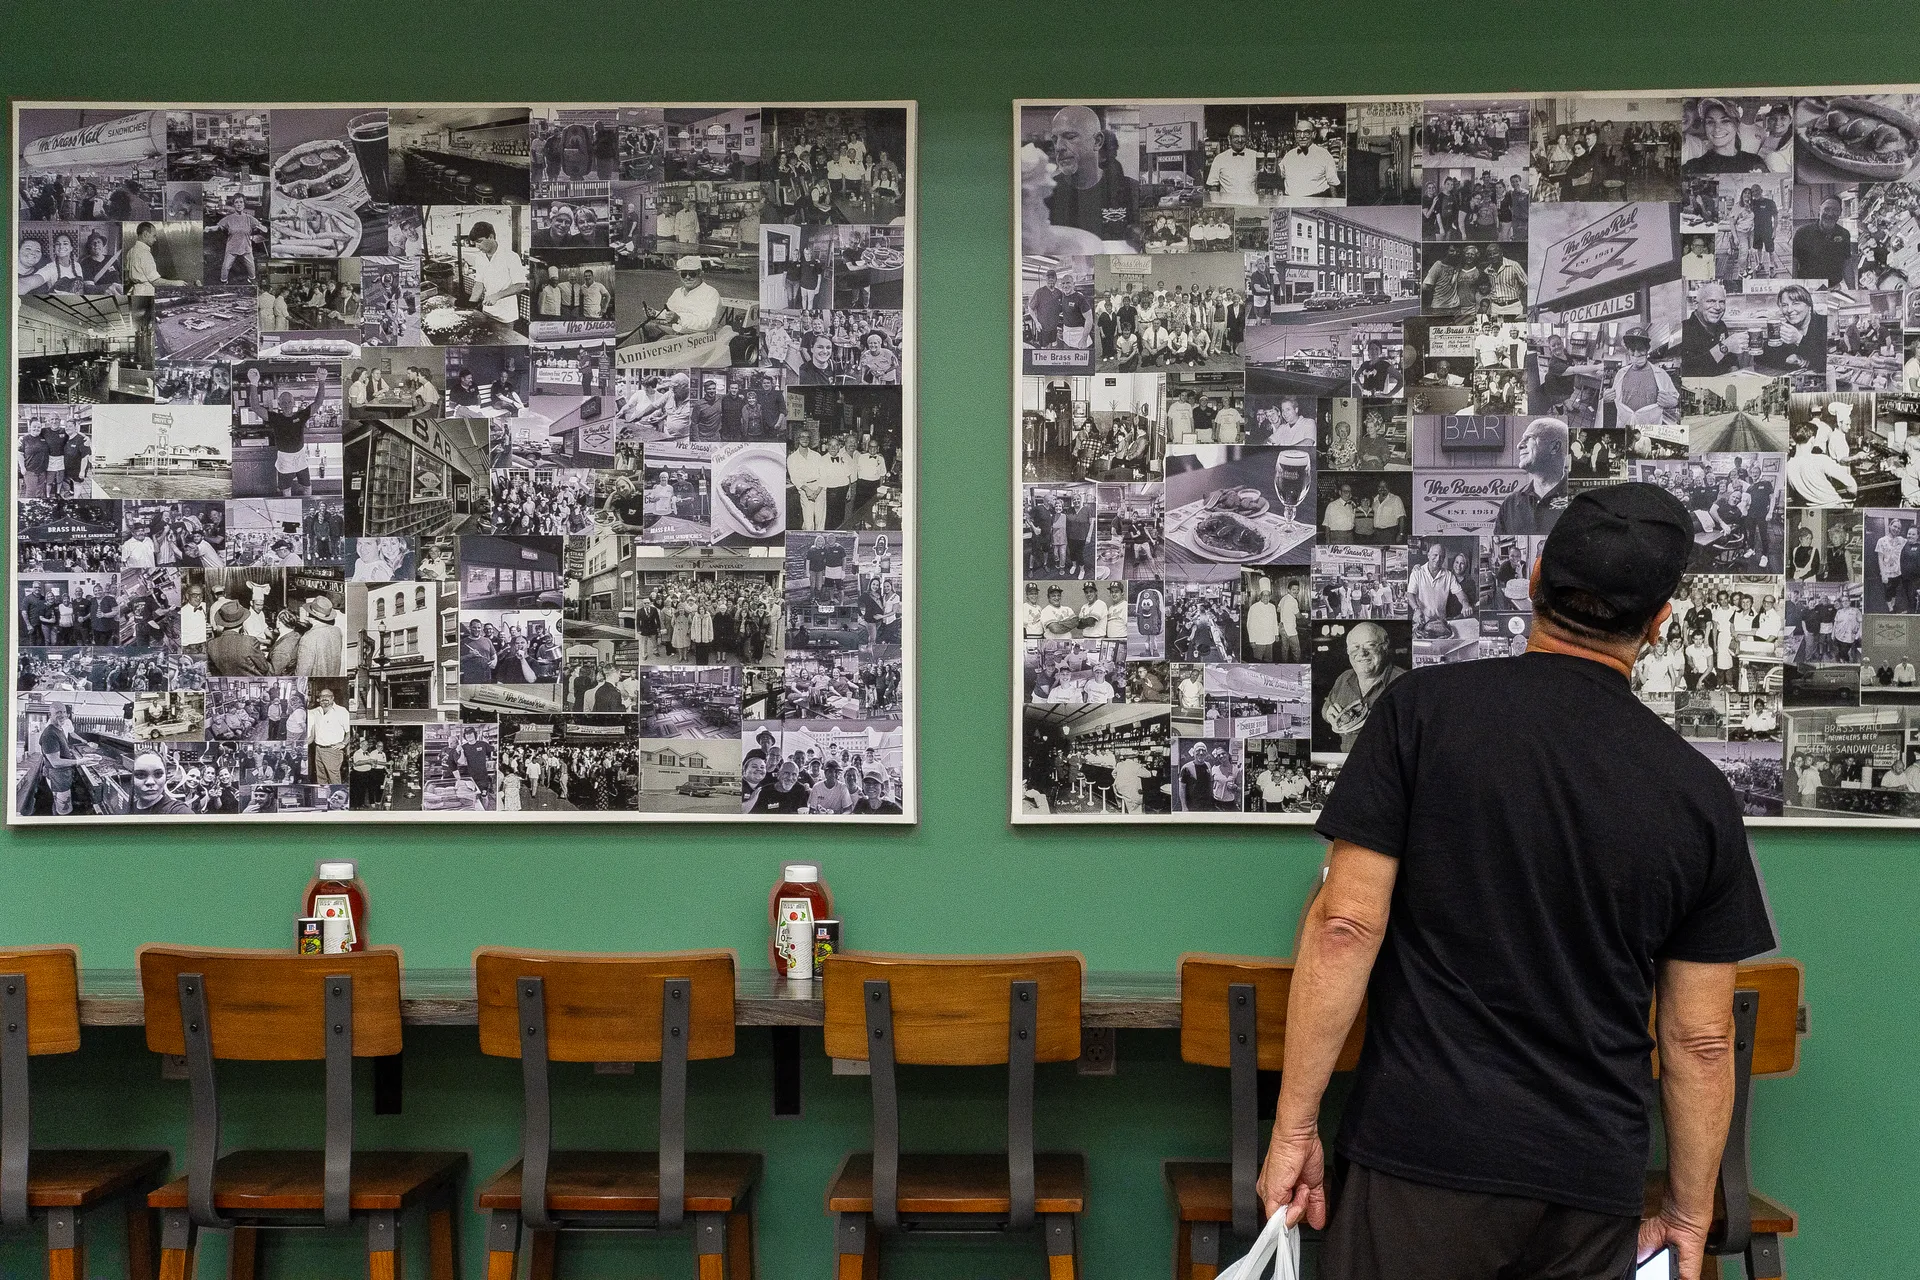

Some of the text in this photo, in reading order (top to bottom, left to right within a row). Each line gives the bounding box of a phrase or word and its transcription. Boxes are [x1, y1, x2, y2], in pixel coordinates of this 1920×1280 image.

[108, 122, 148, 138] SANDWICHES
[51, 130, 78, 151] Brass
[1562, 207, 1638, 255] The Brass Rail
[1594, 247, 1614, 260] 1931
[1562, 294, 1634, 324] COCKTAILS
[563, 321, 582, 333] The
[584, 321, 615, 331] Brass
[617, 332, 718, 366] Anniversary Special
[1050, 352, 1072, 361] Brass
[1074, 352, 1088, 360] Rail
[561, 372, 573, 383] 75
[1444, 416, 1500, 440] BAR
[412, 419, 452, 461] BAR
[675, 441, 689, 450] The
[690, 442, 711, 452] Brass
[1424, 478, 1519, 496] The Brass Rail
[1824, 724, 1853, 733] BRASS
[1807, 744, 1897, 754] STEAK SANDWICHES
